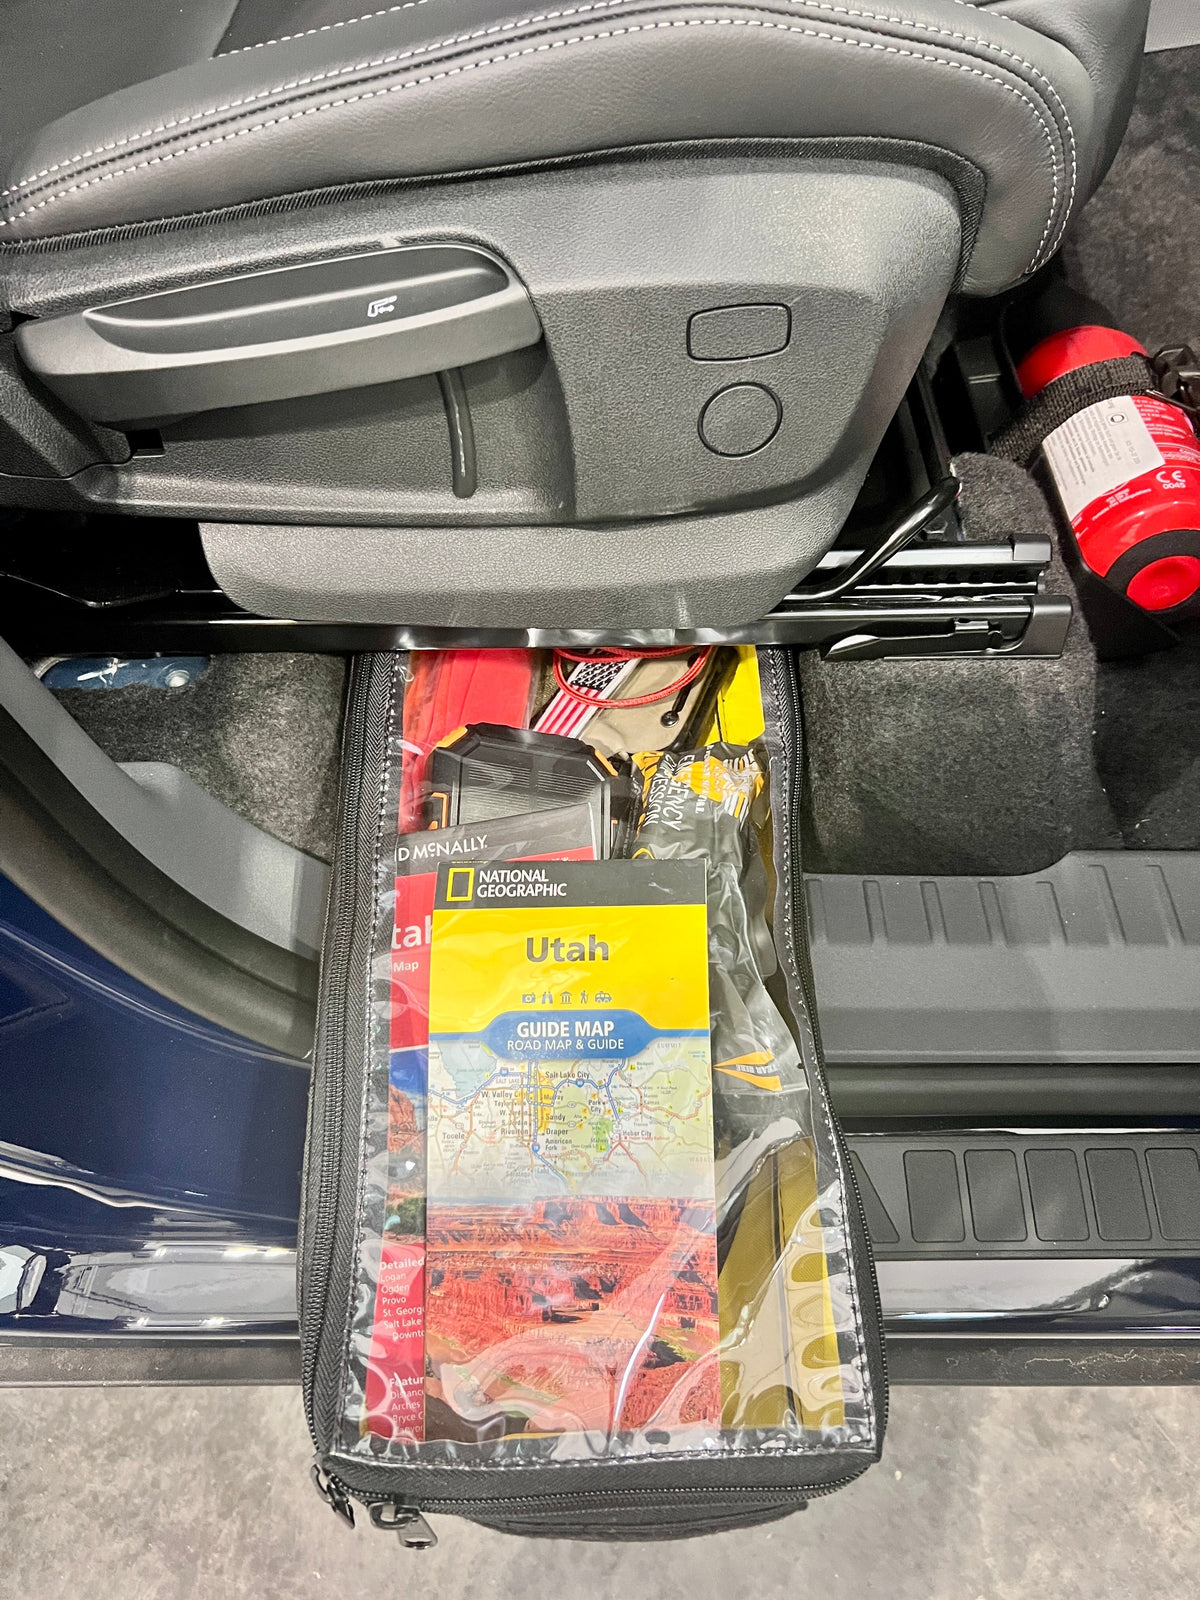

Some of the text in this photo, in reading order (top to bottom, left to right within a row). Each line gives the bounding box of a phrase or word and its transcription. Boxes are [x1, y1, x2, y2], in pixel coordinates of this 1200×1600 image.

[479, 869, 549, 883] NATIONAL
[477, 883, 567, 897] GEOGRAPHIC
[526, 934, 609, 962] Utah
[393, 961, 419, 972] Map
[517, 1021, 615, 1038] GUIDE MAP
[507, 1039, 625, 1050] ROAD MAP & GUIDE
[577, 1071, 590, 1080] City
[545, 1113, 566, 1122] Sandy
[545, 1128, 568, 1137] Draper
[380, 1256, 425, 1271] Detailed
[380, 1272, 407, 1283] Logan
[381, 1284, 410, 1296] Ogden
[382, 1296, 407, 1305] Provo
[383, 1308, 394, 1318] St.
[384, 1317, 422, 1330] Salt Lake
[391, 1401, 421, 1412] Arches
